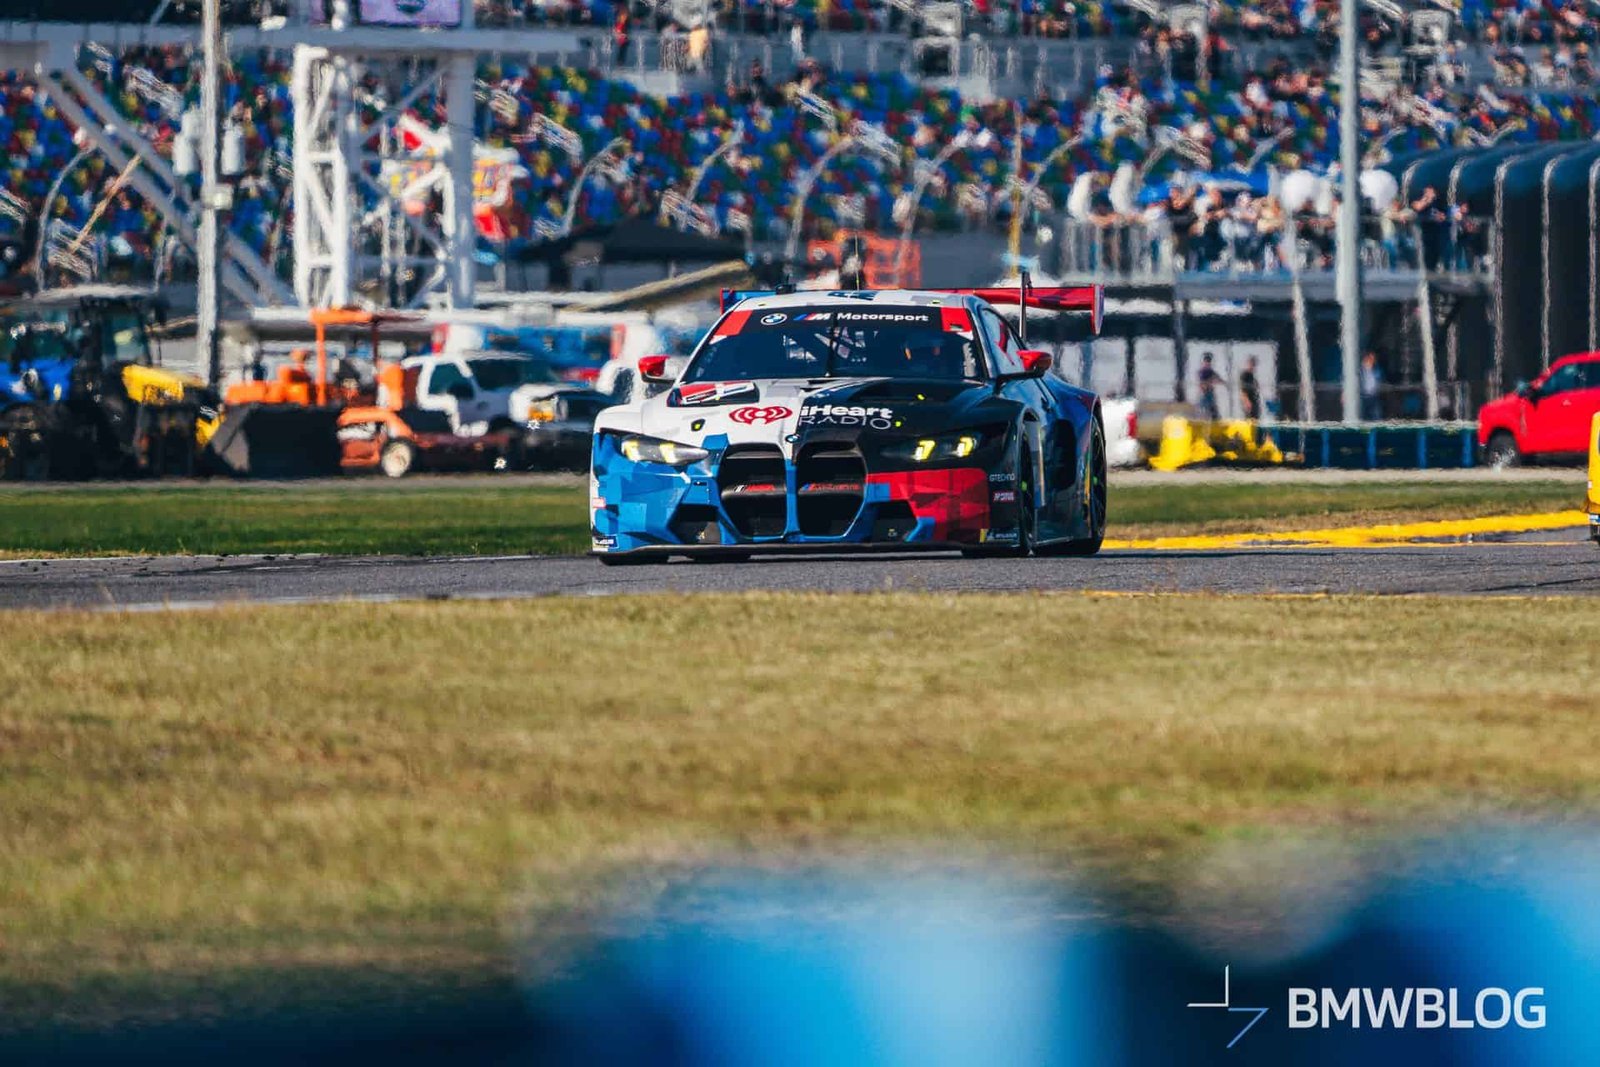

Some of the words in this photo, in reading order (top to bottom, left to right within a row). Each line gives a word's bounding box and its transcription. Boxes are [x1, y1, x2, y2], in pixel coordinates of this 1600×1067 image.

[836, 312, 929, 322] Motorsport
[800, 404, 894, 419] iHeart
[799, 416, 892, 430] RADIO
